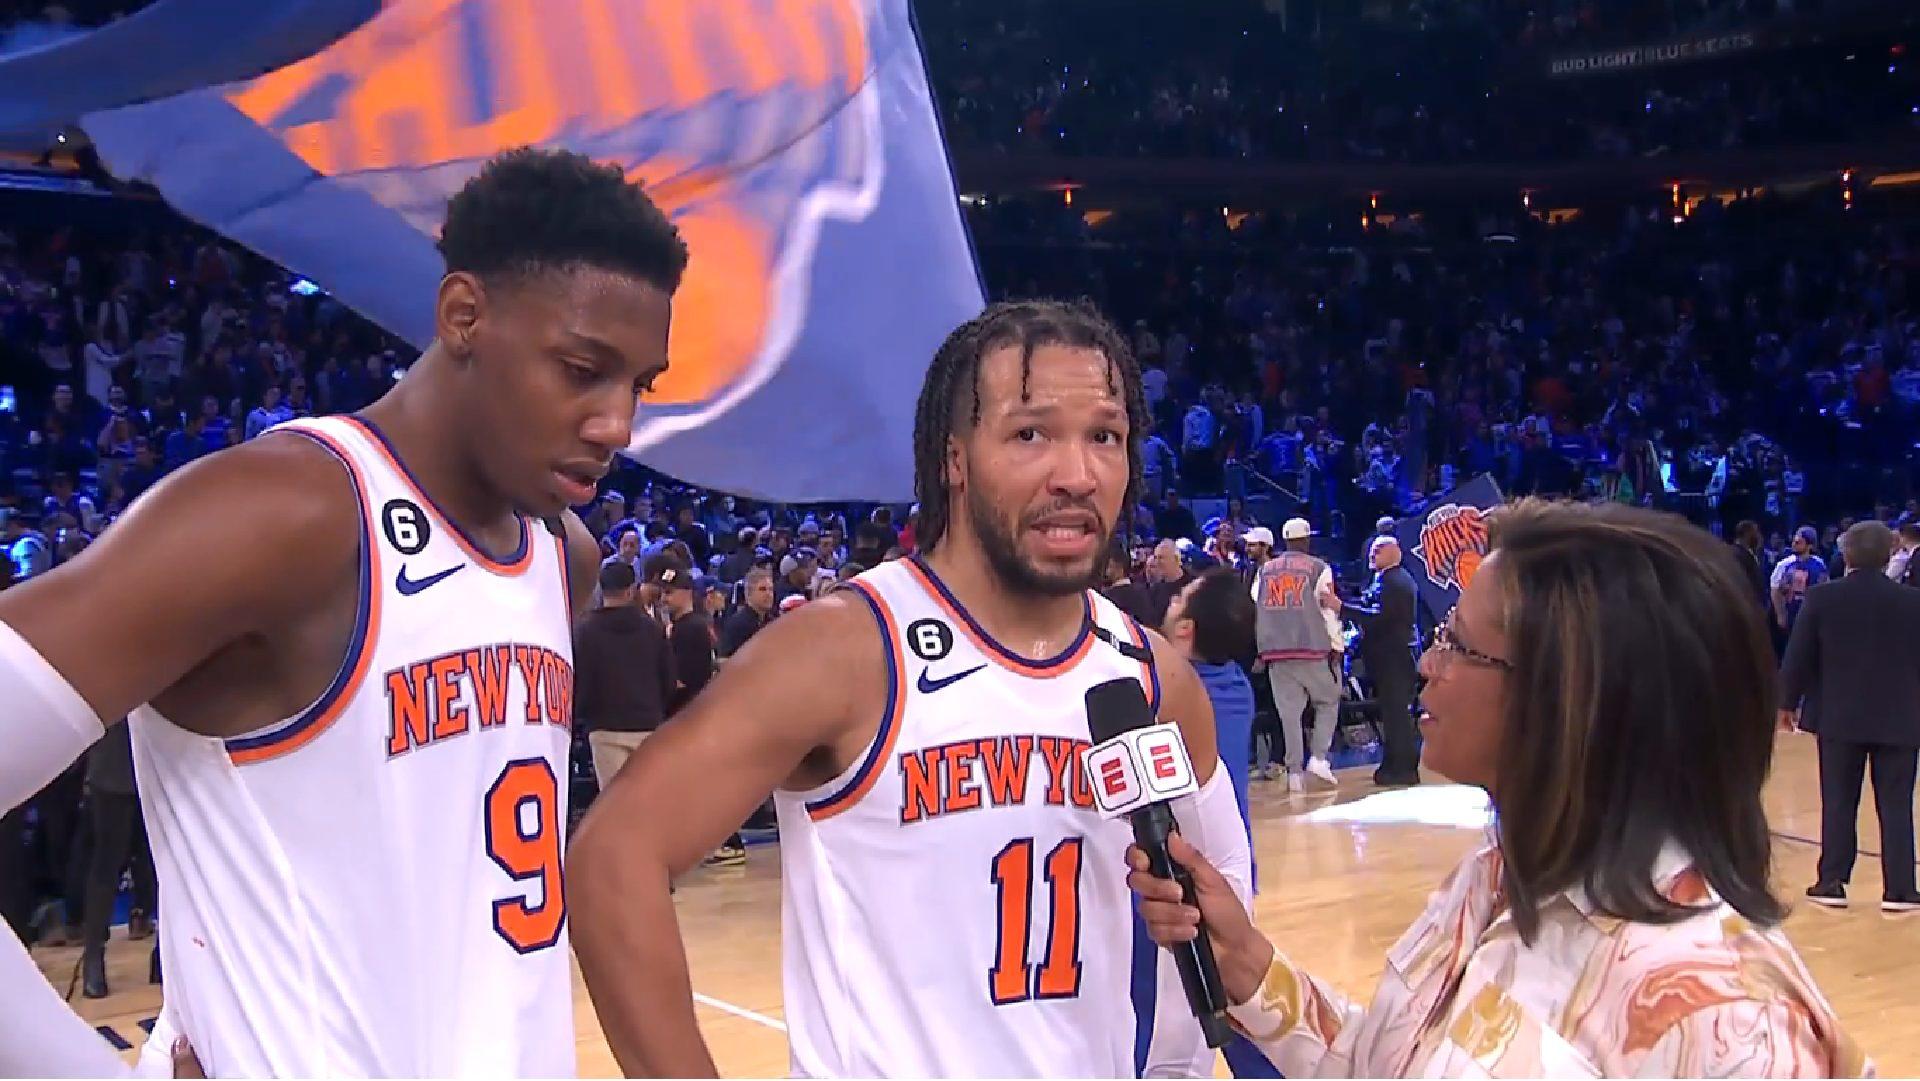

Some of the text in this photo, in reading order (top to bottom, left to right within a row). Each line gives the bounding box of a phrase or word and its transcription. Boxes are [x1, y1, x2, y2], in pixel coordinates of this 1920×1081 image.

[1552, 57, 1585, 74] BUD
[389, 506, 420, 549] 6
[914, 624, 942, 656] 6
[386, 643, 573, 760] NEW YOR
[900, 735, 1098, 826] NEW YO
[485, 757, 567, 954] 9
[989, 837, 1083, 1006] 11
